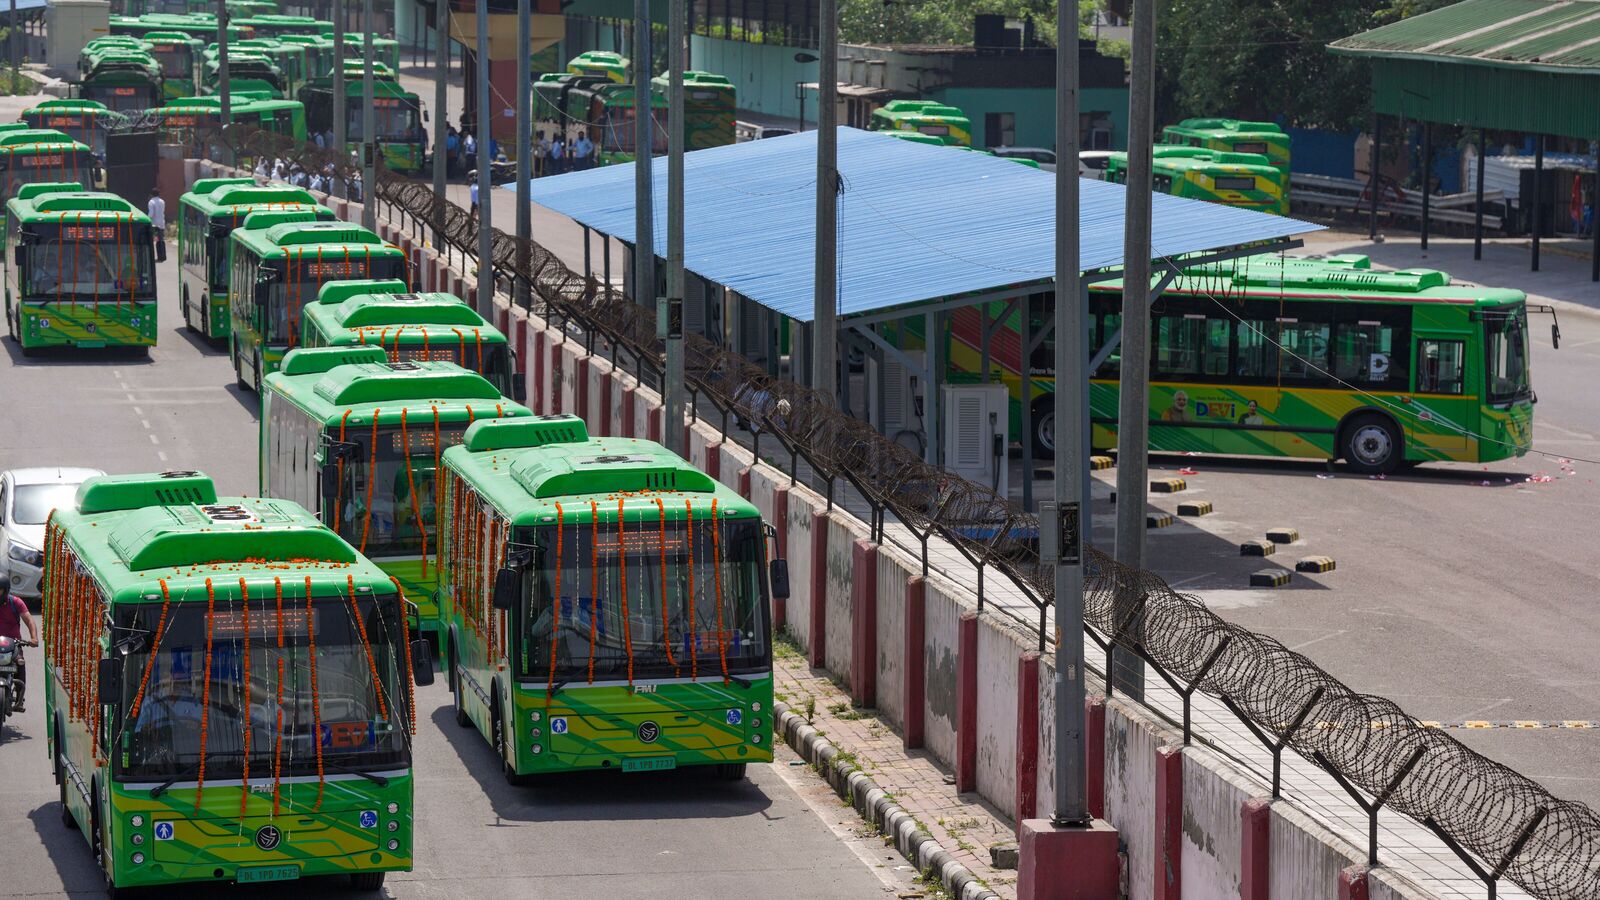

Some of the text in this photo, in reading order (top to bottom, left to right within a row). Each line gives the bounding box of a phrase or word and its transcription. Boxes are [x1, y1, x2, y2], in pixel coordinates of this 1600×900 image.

[628, 761, 637, 769] DL
[656, 759, 674, 768] 7737
[244, 871, 254, 881] DL
[277, 868, 298, 879] 7625
